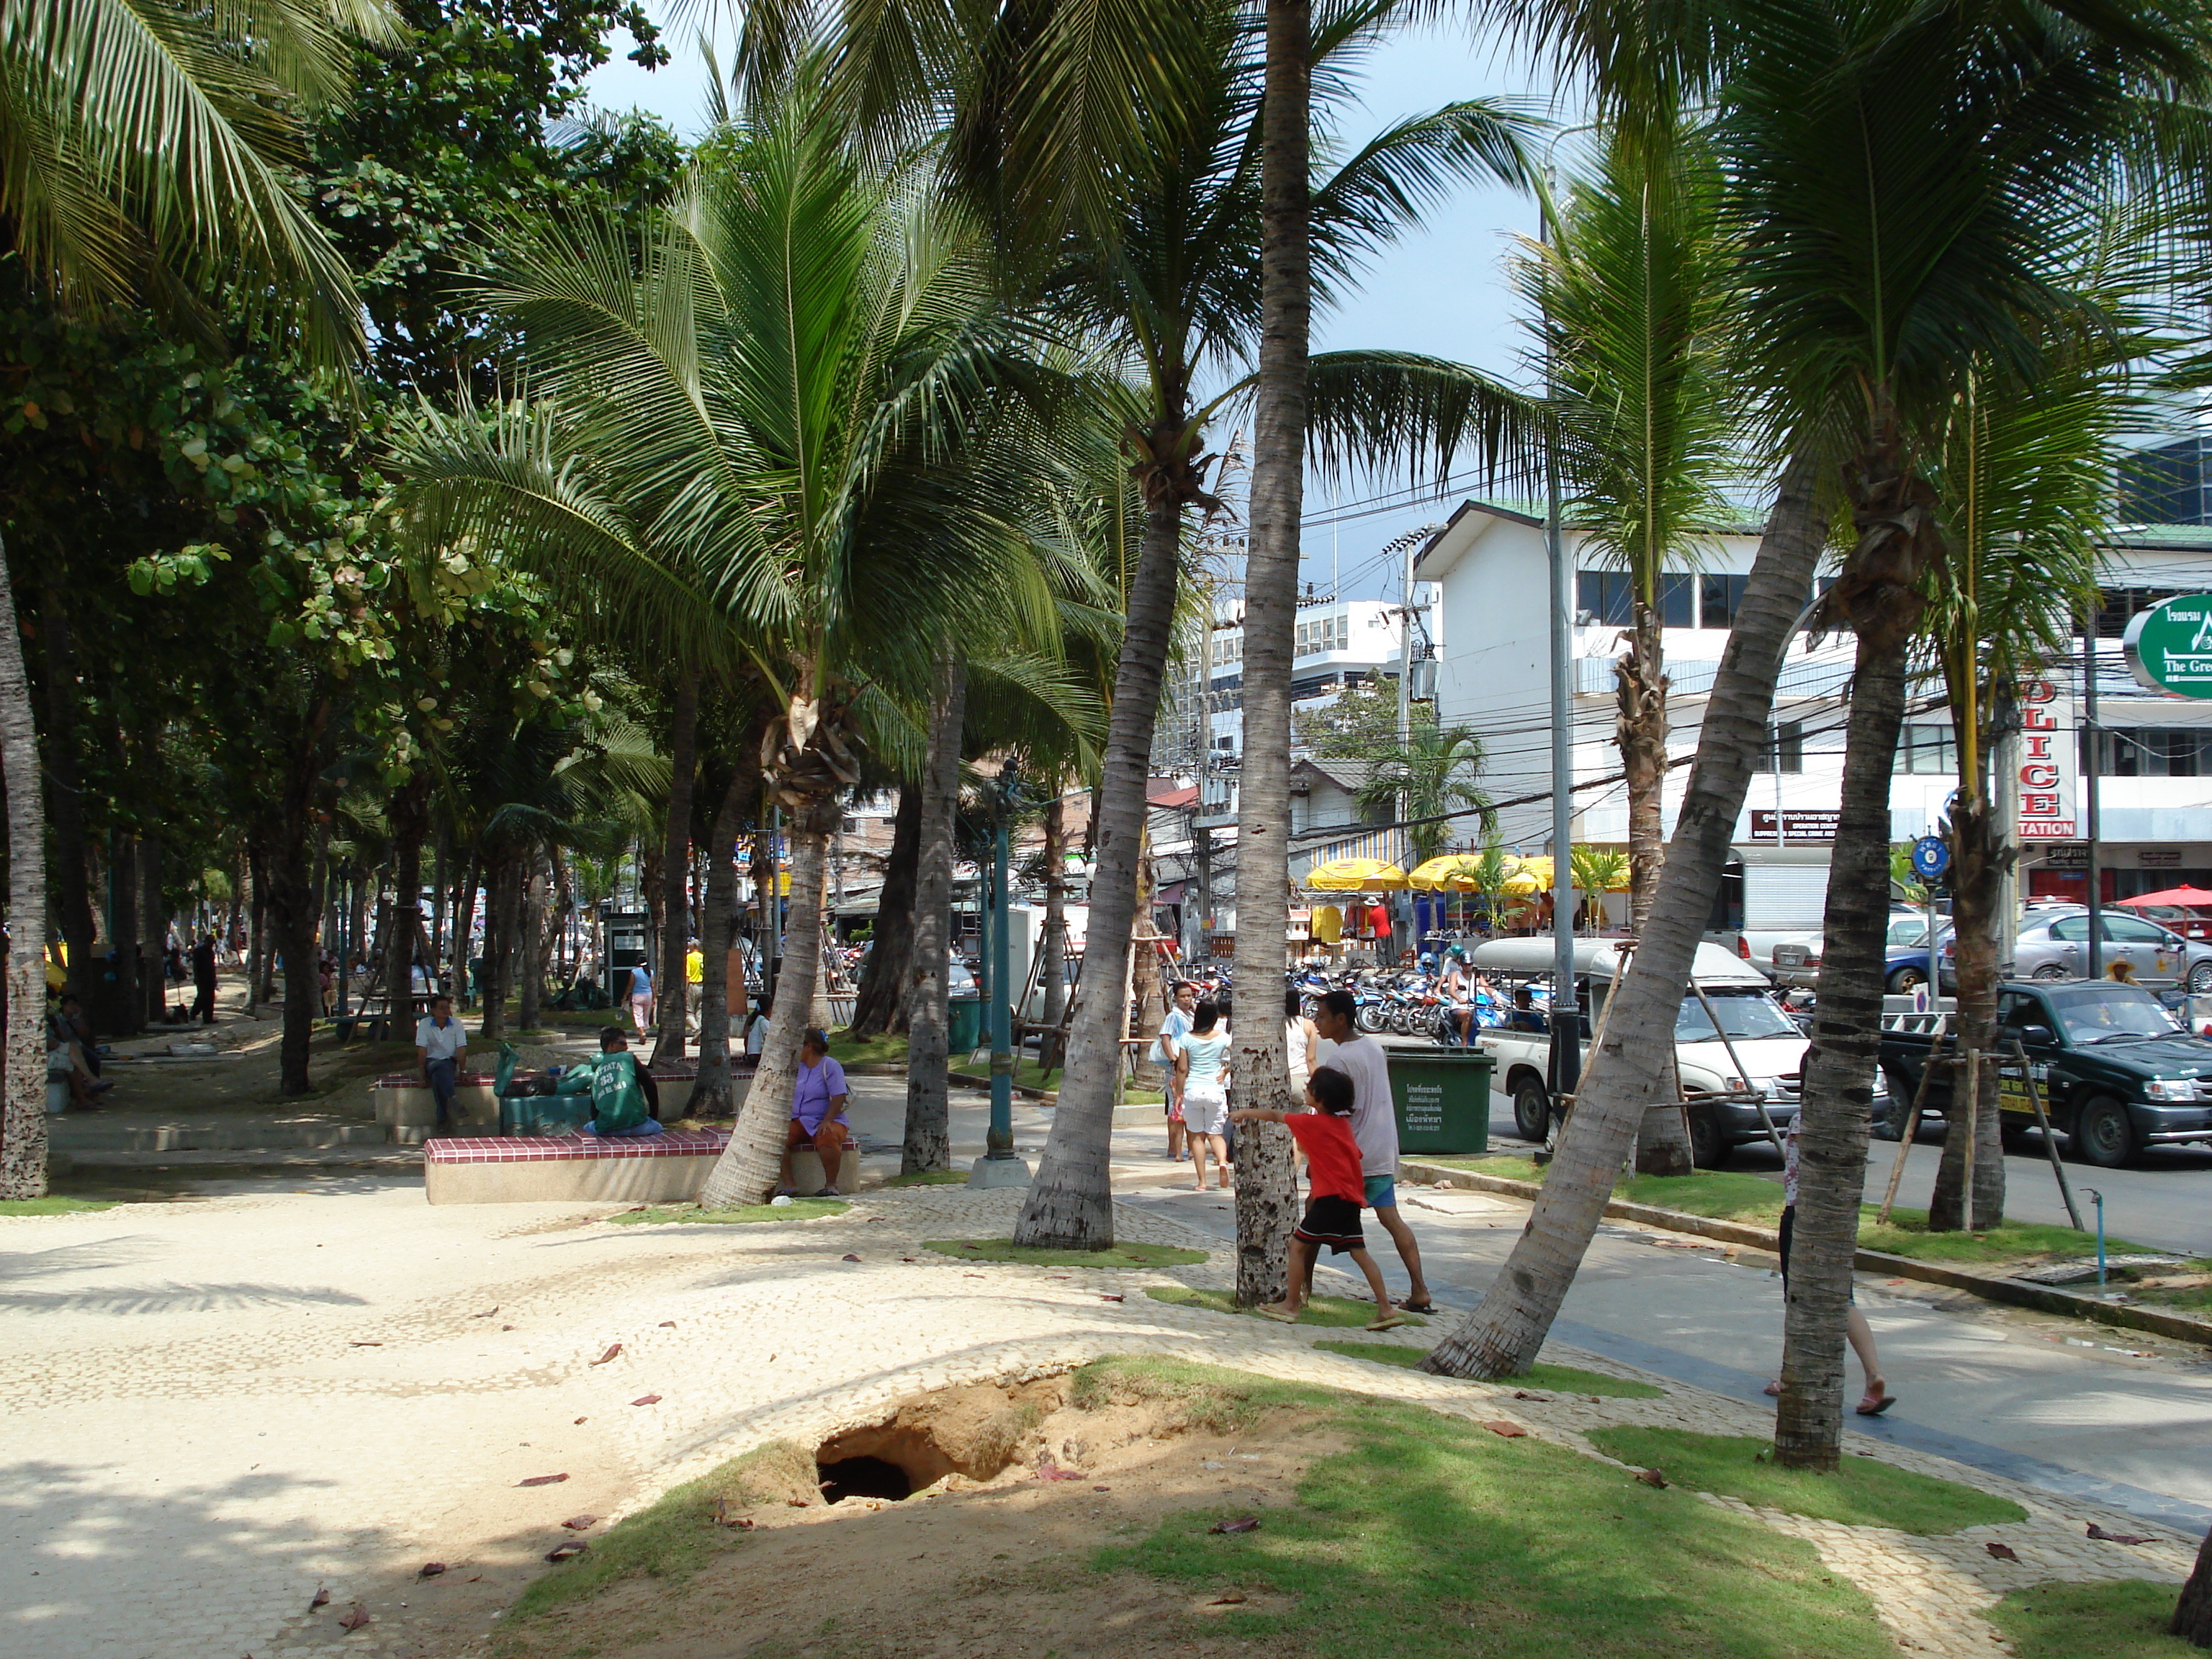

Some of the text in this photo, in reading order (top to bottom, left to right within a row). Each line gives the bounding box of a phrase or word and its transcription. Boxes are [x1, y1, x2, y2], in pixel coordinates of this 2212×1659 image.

[2165, 605, 2200, 621] โรงแรม
[2164, 660, 2212, 673] The Gre
[2019, 680, 2060, 816] OLICE
[2019, 823, 2073, 835] TATION
